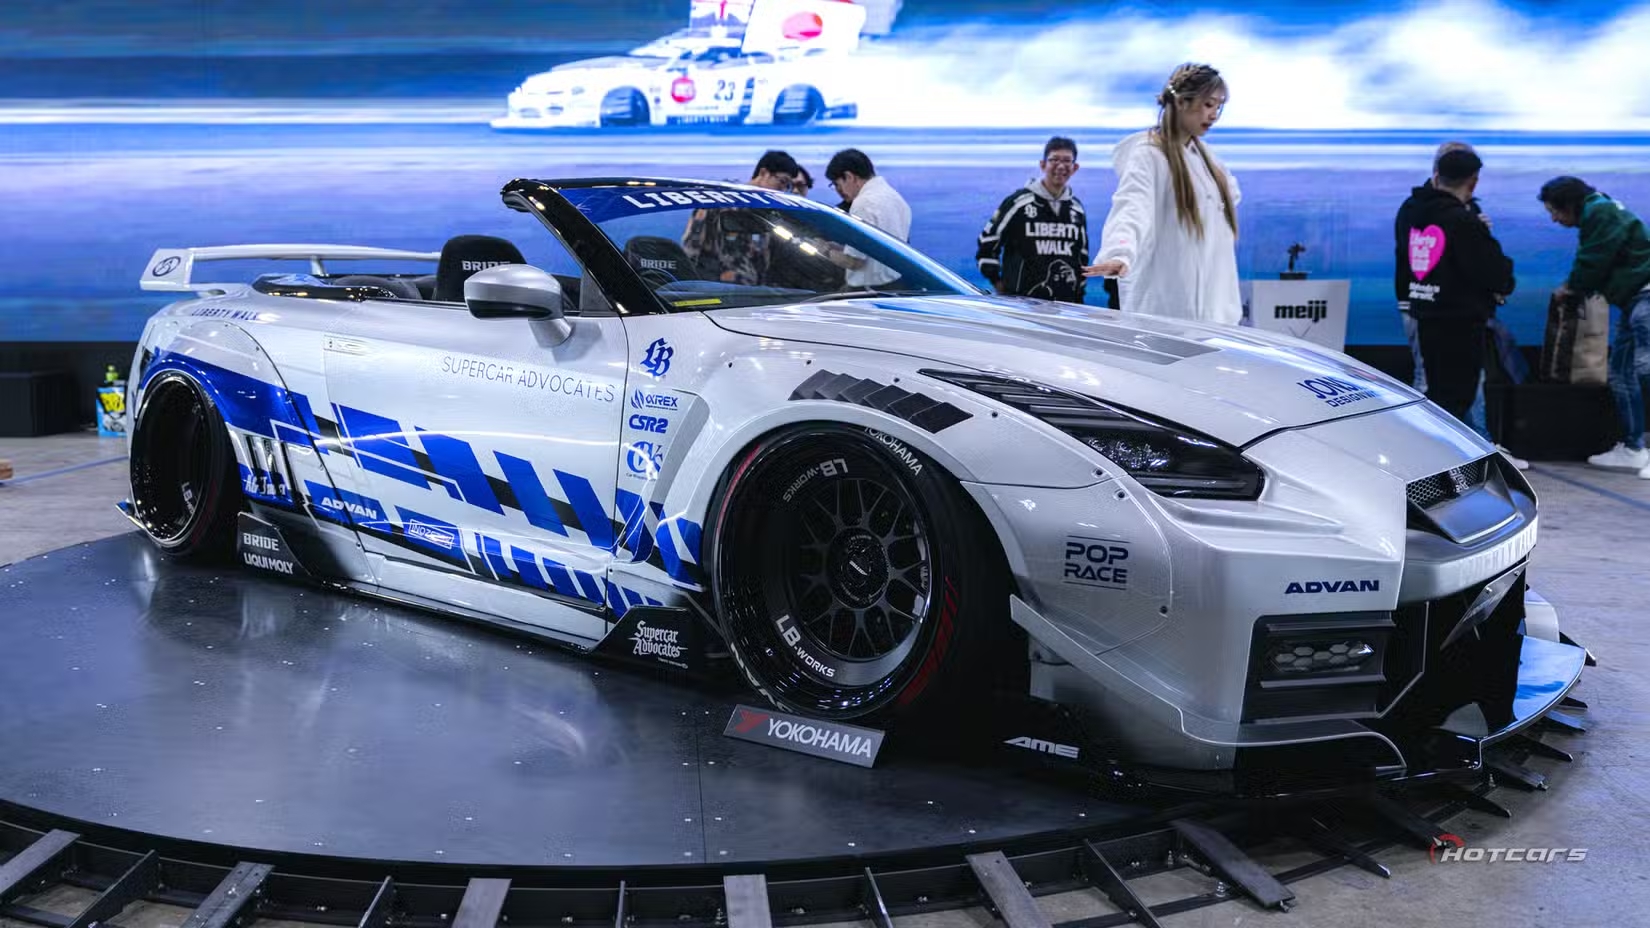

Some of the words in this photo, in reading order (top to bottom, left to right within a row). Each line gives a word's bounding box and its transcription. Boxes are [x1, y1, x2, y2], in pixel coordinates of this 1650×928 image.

[713, 79, 736, 101] 23
[622, 190, 771, 209] LIBERTY
[1025, 222, 1079, 240] LIBERTY
[1035, 240, 1074, 256] WALK
[640, 258, 677, 269] BRIDE
[1274, 300, 1328, 323] meiji
[441, 355, 514, 384] SUPERCAR
[517, 369, 616, 402] ADVOCATES
[629, 414, 668, 434] CSR2
[320, 496, 378, 520] ADVAN
[243, 532, 280, 551] BRIDE
[1065, 541, 1129, 565] POP
[1064, 562, 1128, 584] RACE
[1284, 579, 1380, 595] ADVAN
[633, 620, 679, 643] Supercar
[627, 638, 689, 658] Advocates
[767, 718, 872, 758] YOKOHAMA
[1002, 736, 1080, 759] AME
